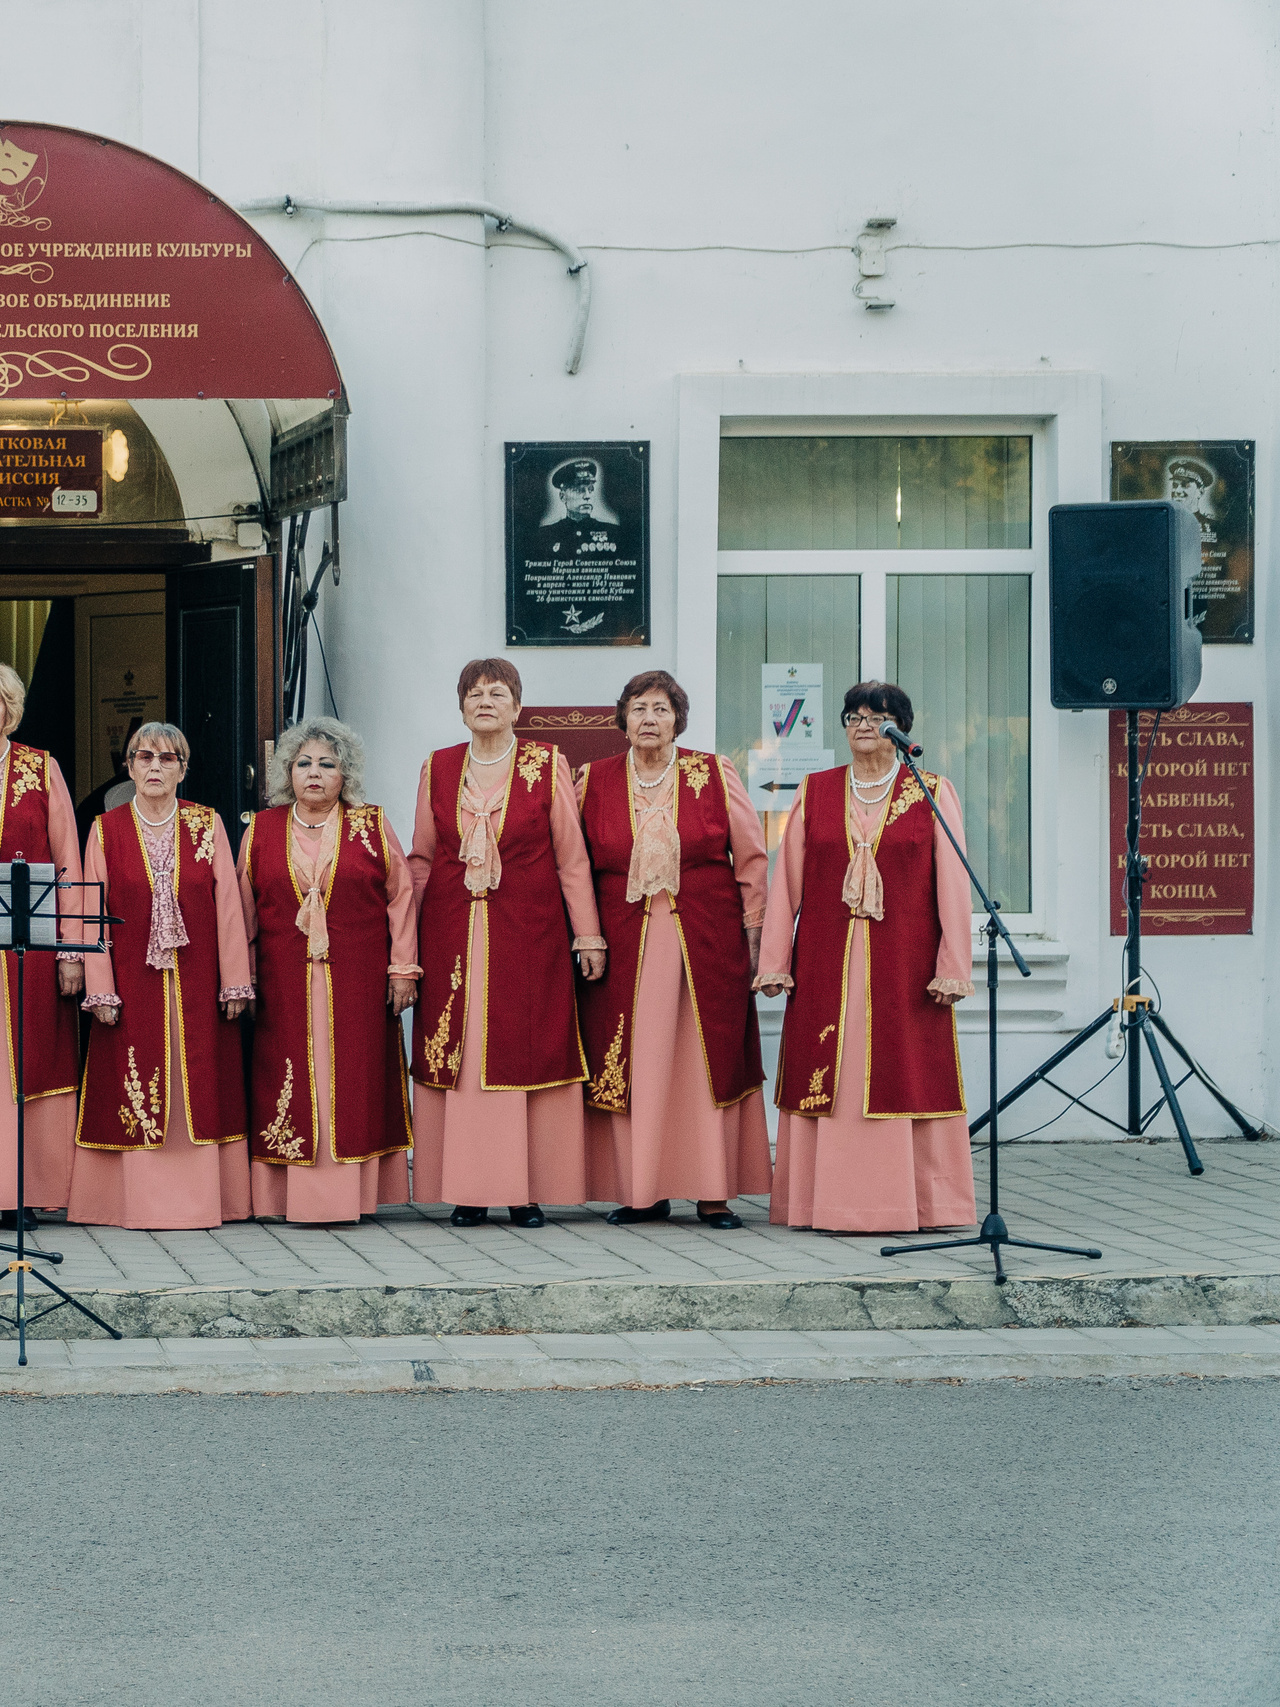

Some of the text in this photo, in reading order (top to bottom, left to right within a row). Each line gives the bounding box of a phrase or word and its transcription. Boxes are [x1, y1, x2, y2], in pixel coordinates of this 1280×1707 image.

[28, 242, 152, 260] УЧРЕЖДЕНИЕ
[156, 242, 252, 258] КУЛЬТУРЫ
[33, 292, 171, 310] ОБЪЕДИНЕНИЕ
[88, 322, 199, 339] ПОСЕЛЕНИЯ
[36, 496, 50, 507] №
[525, 560, 551, 568] Трижды
[525, 574, 565, 582] Покрышкин
[1177, 731, 1245, 747] СЛАВА,
[1213, 761, 1251, 777] НЕТ
[1140, 792, 1235, 809] АБВЕНЬЯ,
[1124, 823, 1245, 840] СТЬ СЛАВА,
[1117, 851, 1251, 869] КТОРОЙ НЕТ
[1150, 884, 1218, 901] КОНЦА
